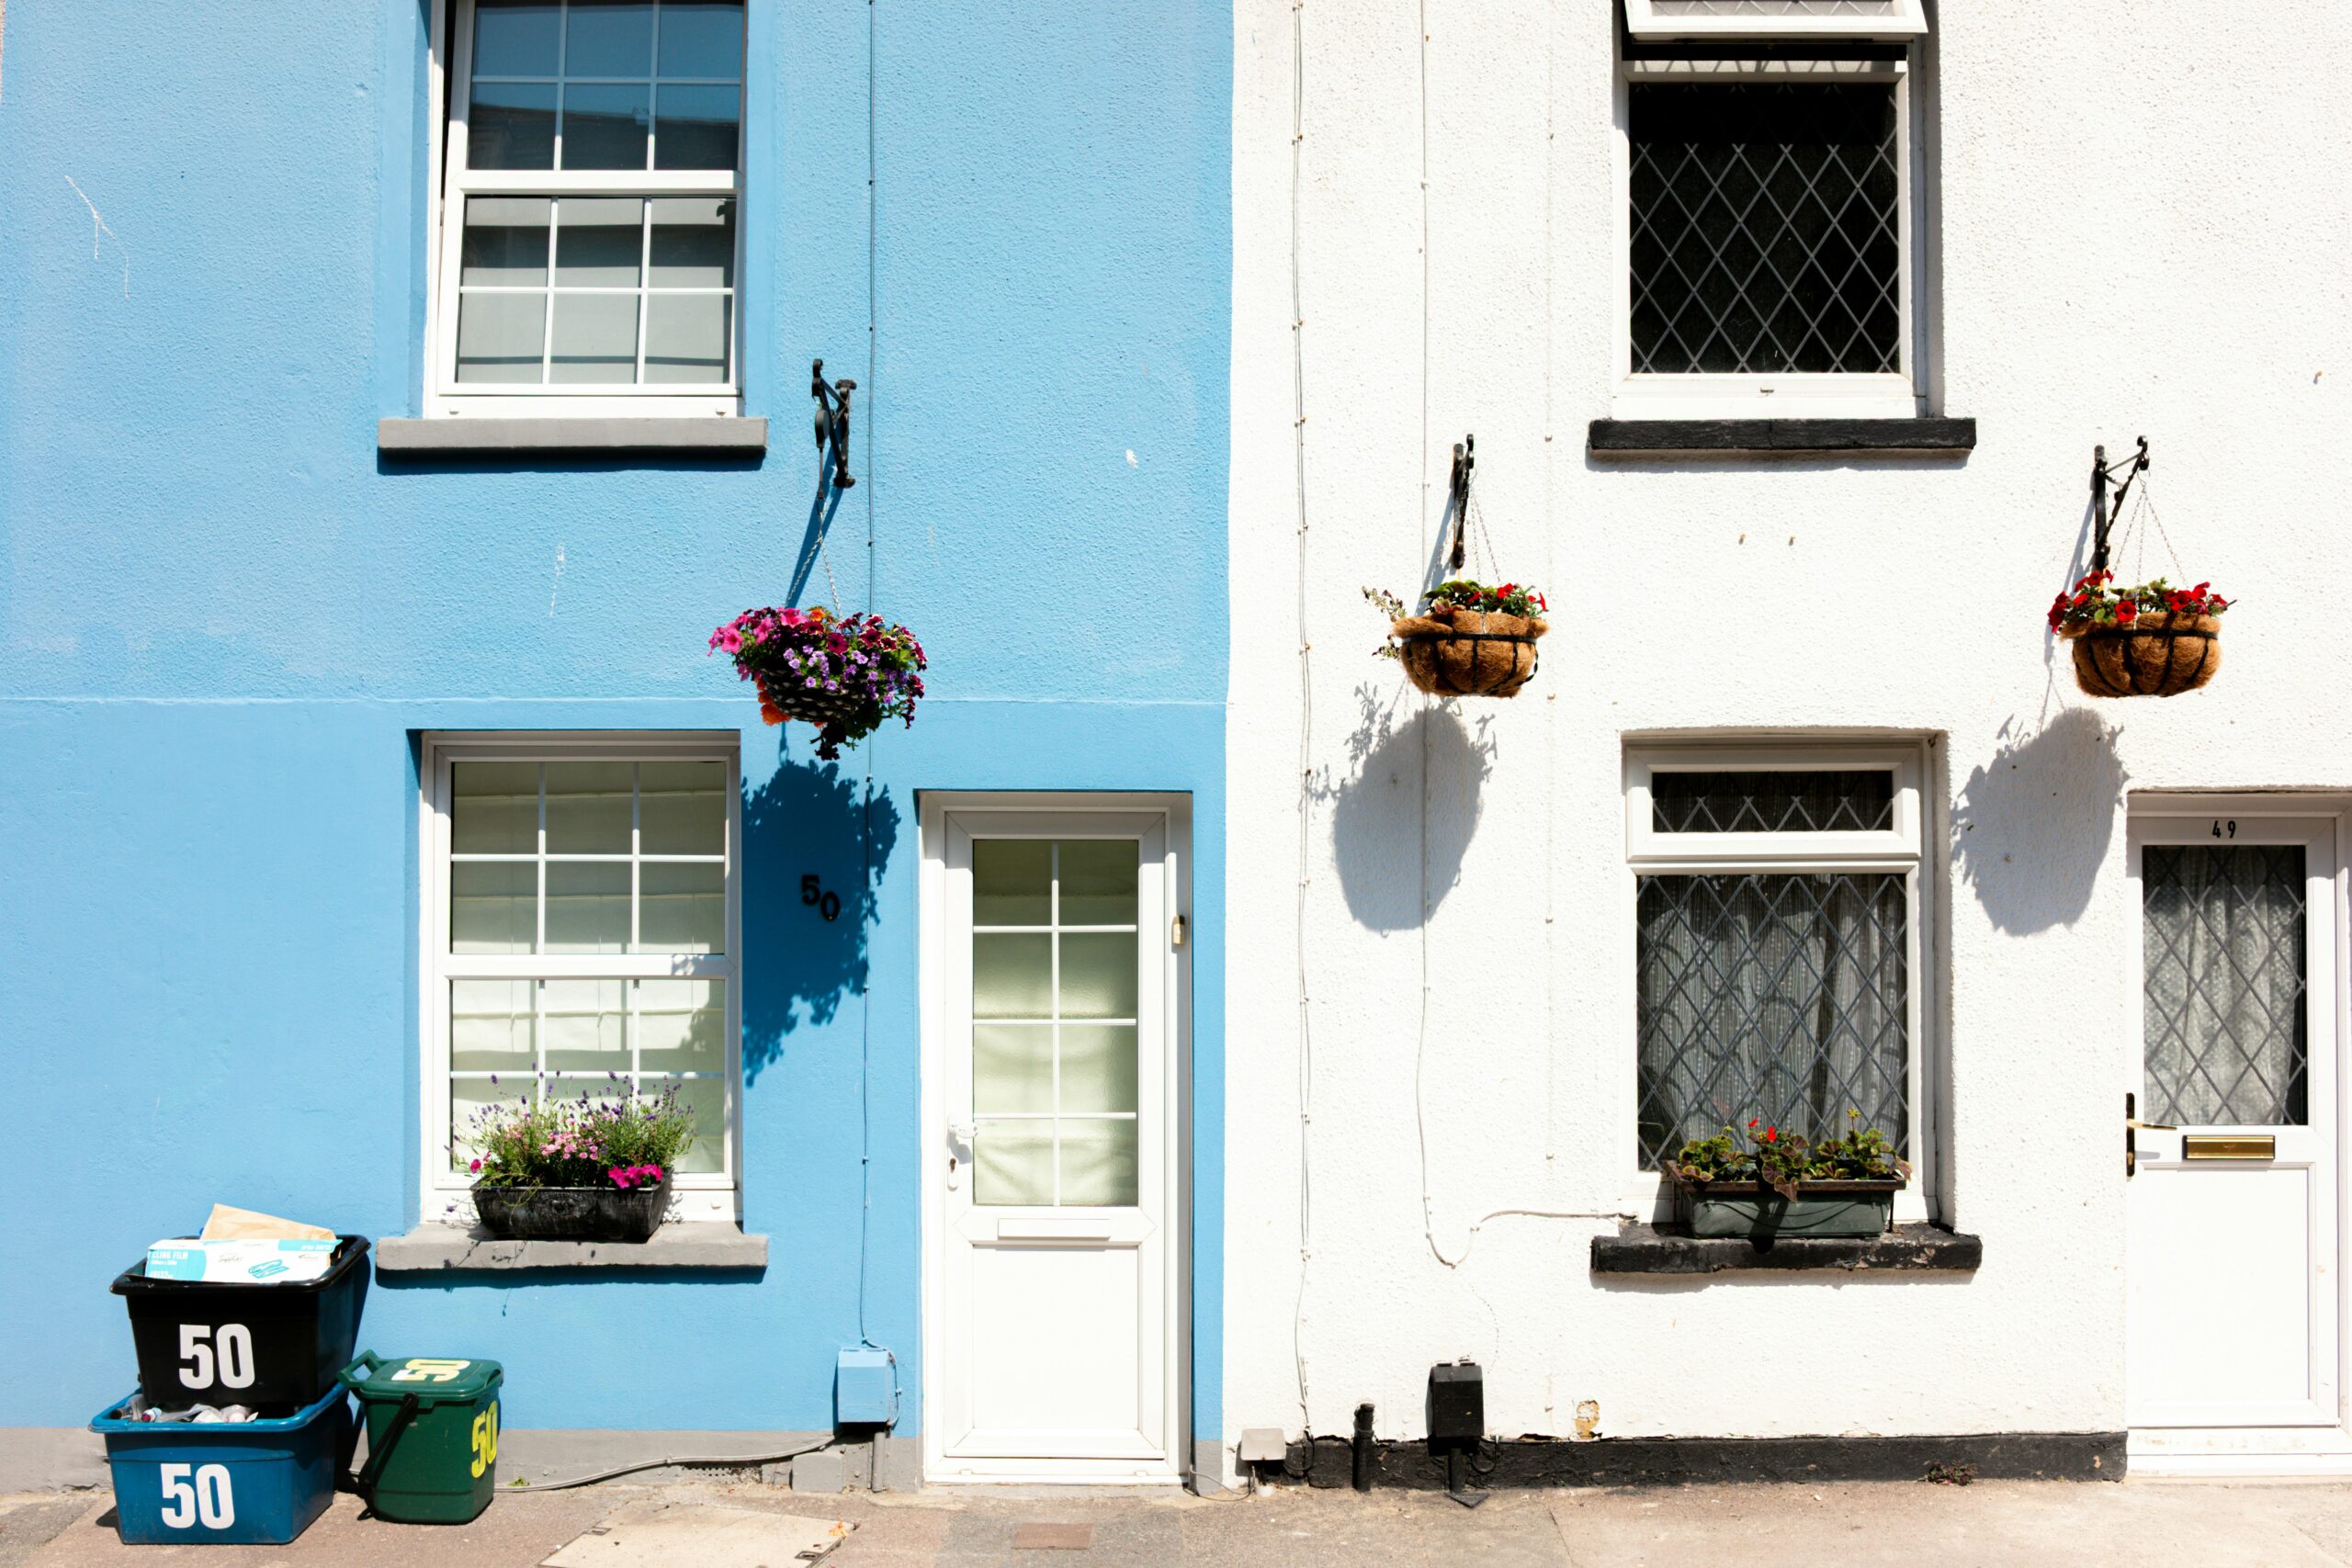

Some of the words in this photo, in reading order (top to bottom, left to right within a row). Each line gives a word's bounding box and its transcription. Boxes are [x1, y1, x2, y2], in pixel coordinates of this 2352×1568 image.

[2211, 819, 2236, 839] 49
[801, 874, 841, 922] 50
[173, 1250, 189, 1260] FILM
[179, 1324, 255, 1390] 50
[390, 1359, 471, 1382] 50
[471, 1400, 498, 1479] 50
[160, 1463, 235, 1530] 50
